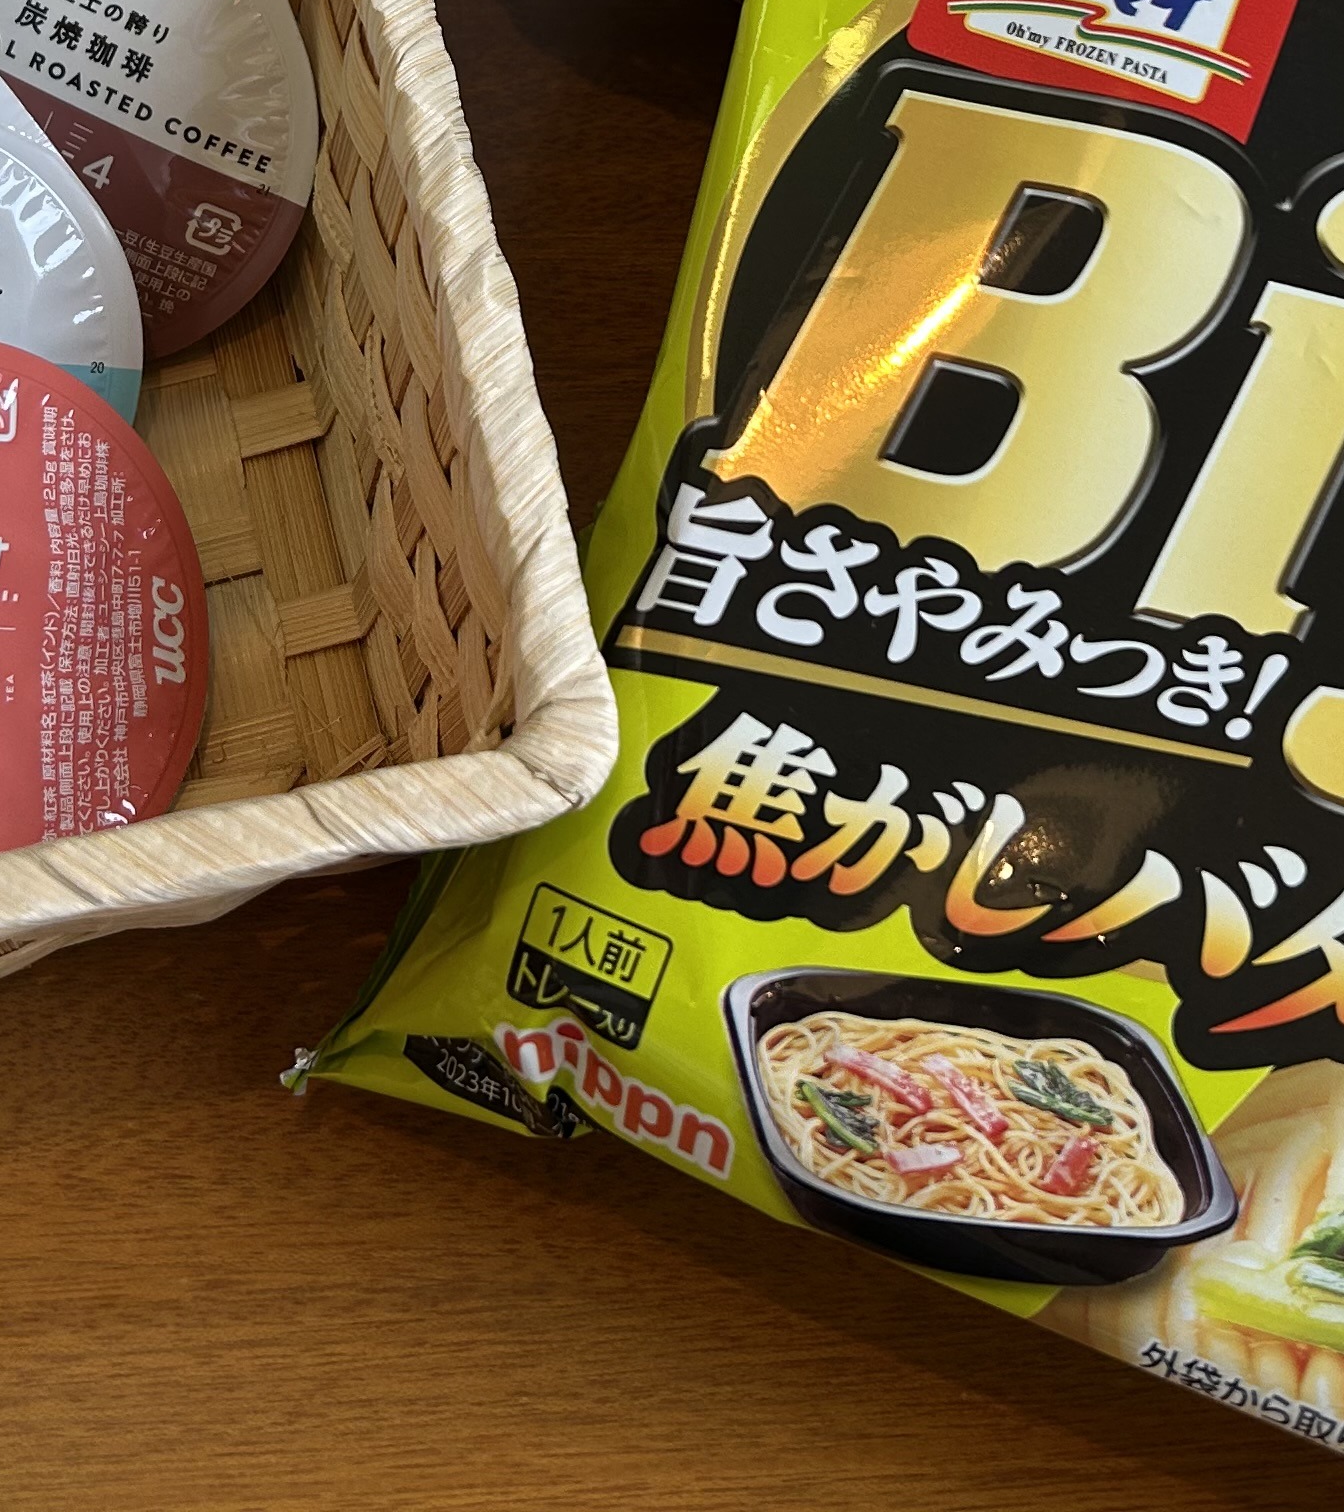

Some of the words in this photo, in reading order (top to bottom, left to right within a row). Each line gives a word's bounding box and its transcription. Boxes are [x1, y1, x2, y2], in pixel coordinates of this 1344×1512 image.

[1006, 20, 1052, 49] Oh'my
[1055, 35, 1120, 68] FROZEN
[1120, 55, 1169, 86] PASTA
[28, 53, 154, 123] ROASTED
[164, 116, 272, 174] COFFEE
[82, 154, 115, 190] 4
[40, 405, 58, 456] 賞味期
[44, 459, 61, 554] 内容量:2.5g
[109, 469, 127, 525] 加工所:
[127, 547, 147, 717] 静岡県富士市増川51-1
[635, 484, 1292, 744] 旨さやみつき!
[5, 672, 15, 703] TEA
[112, 744, 129, 798] 式会社
[548, 904, 647, 983] 1人前
[513, 951, 638, 1042] トレー入り
